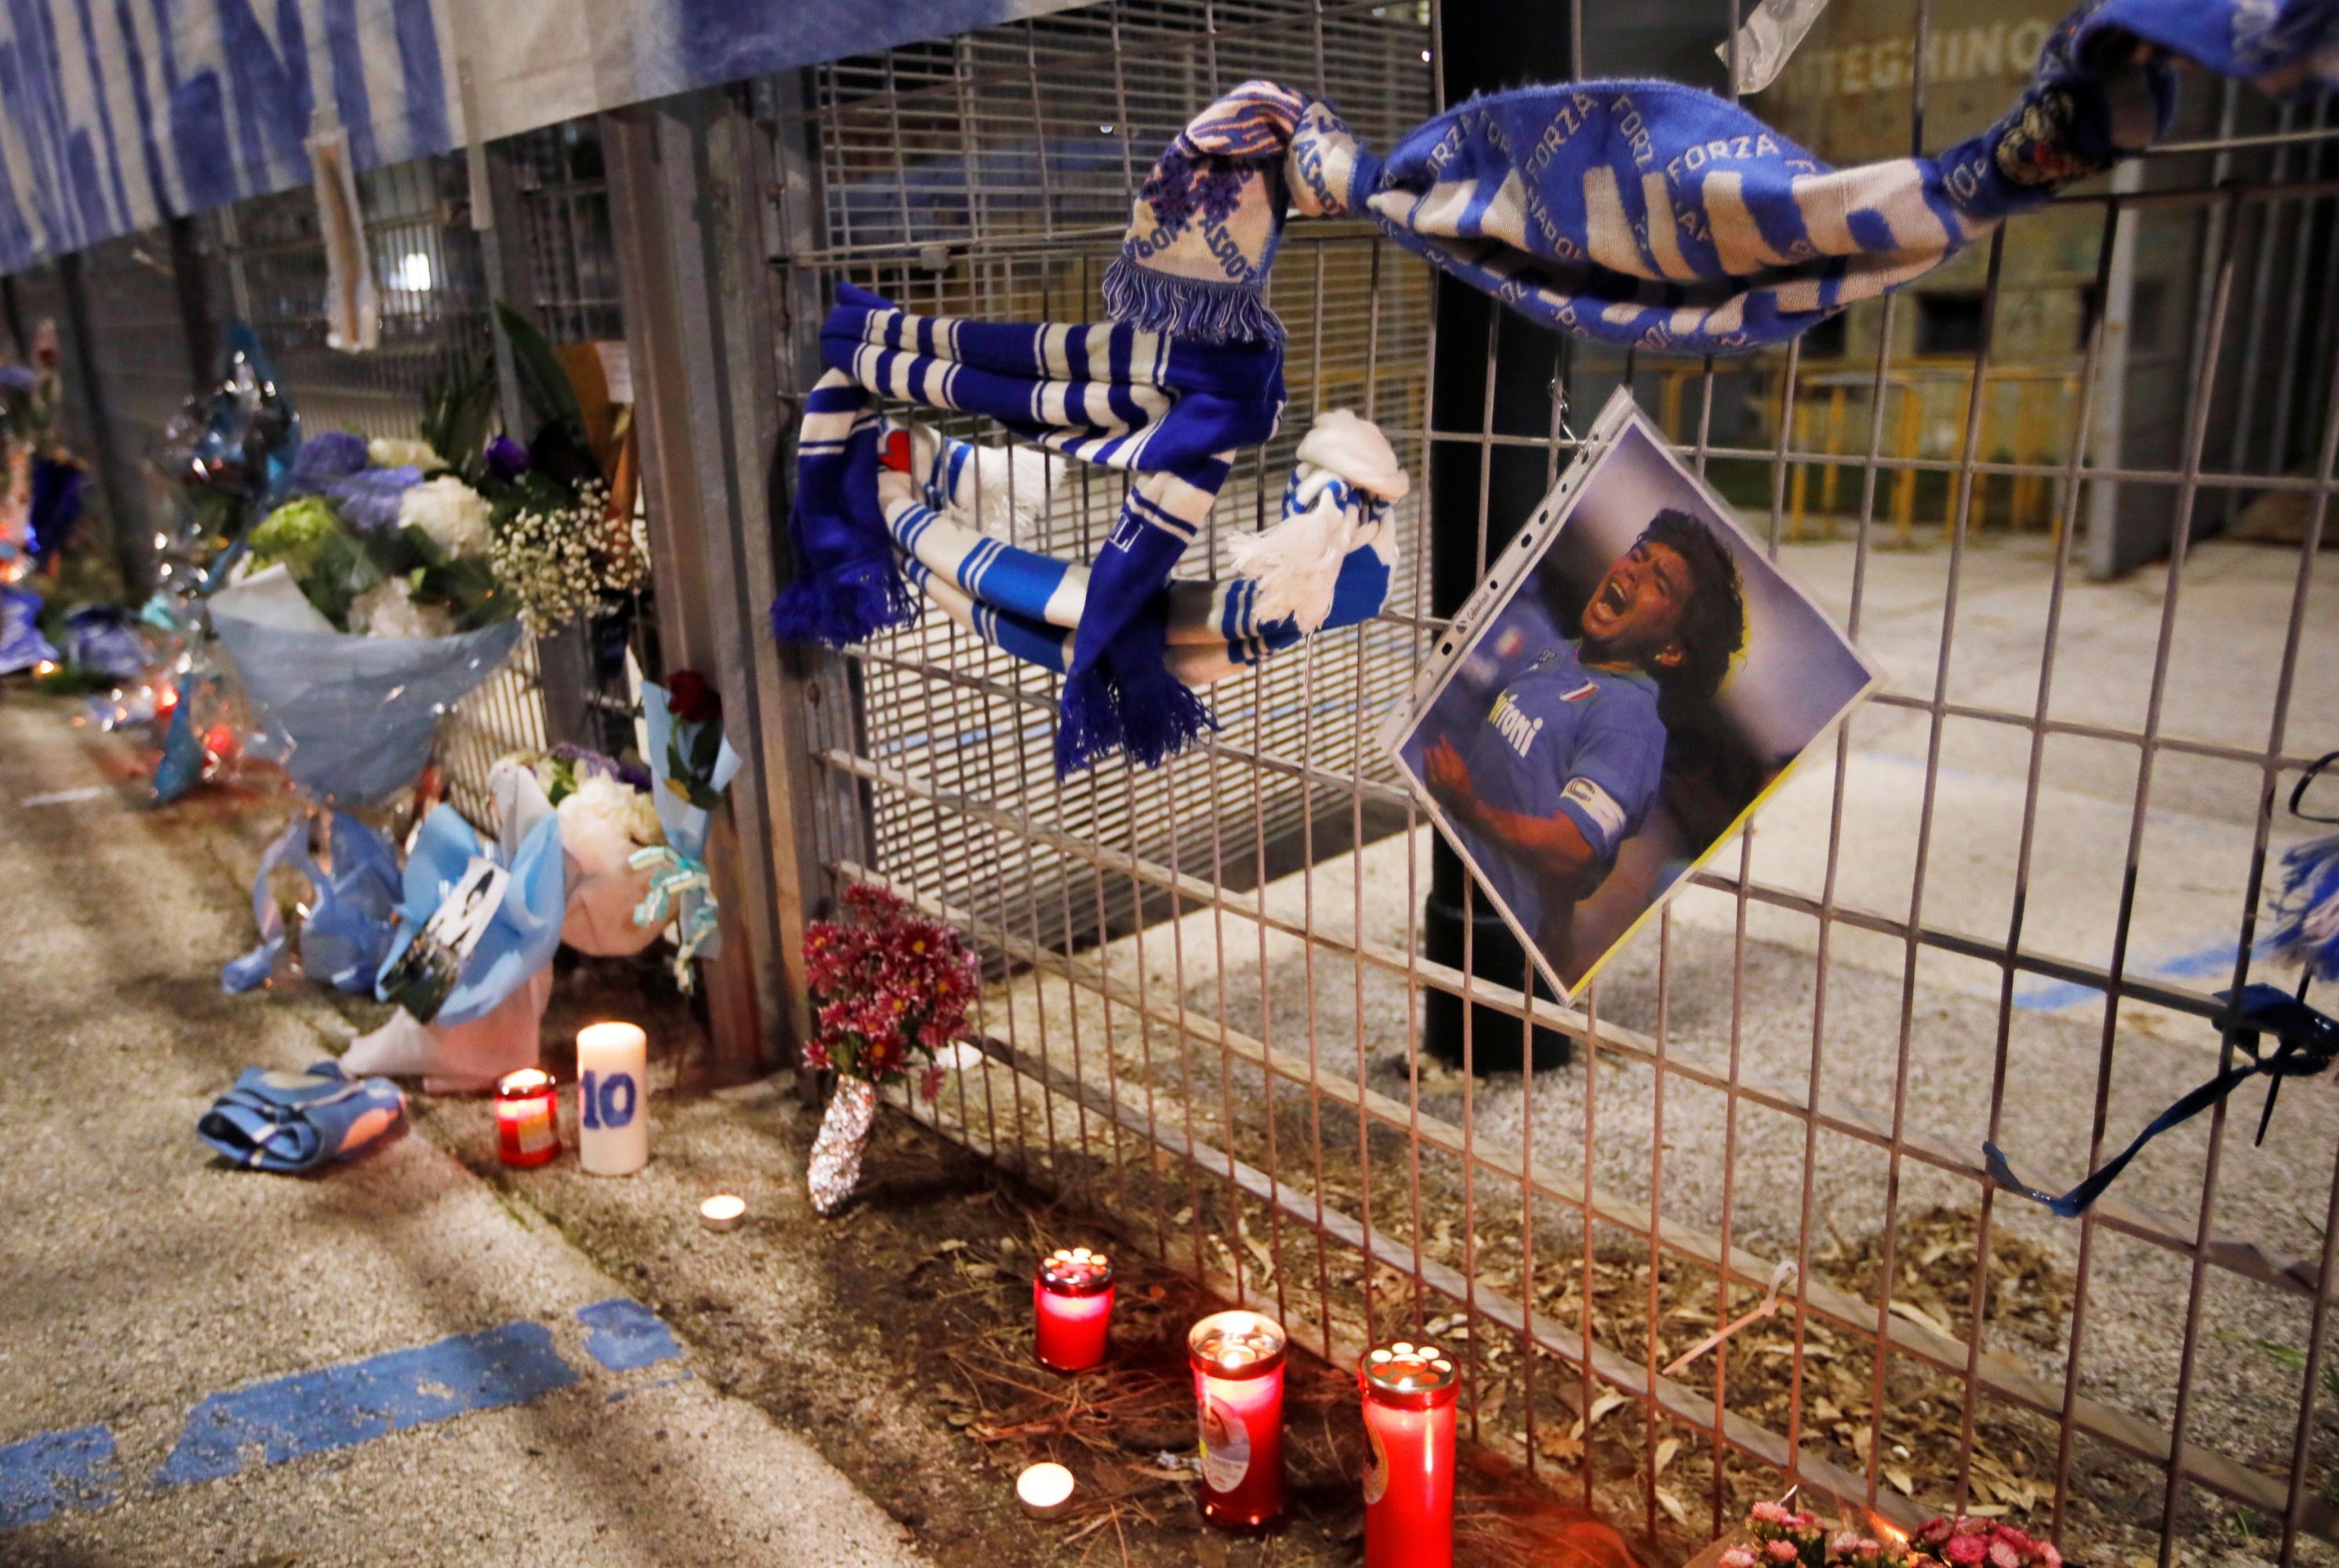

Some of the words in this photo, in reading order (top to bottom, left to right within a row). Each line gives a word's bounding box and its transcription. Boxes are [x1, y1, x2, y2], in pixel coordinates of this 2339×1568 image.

[1524, 92, 1599, 183] FORZA
[1611, 94, 1654, 169] FORZ
[1666, 132, 1781, 187] FORZA
[581, 1069, 637, 1129] 10
